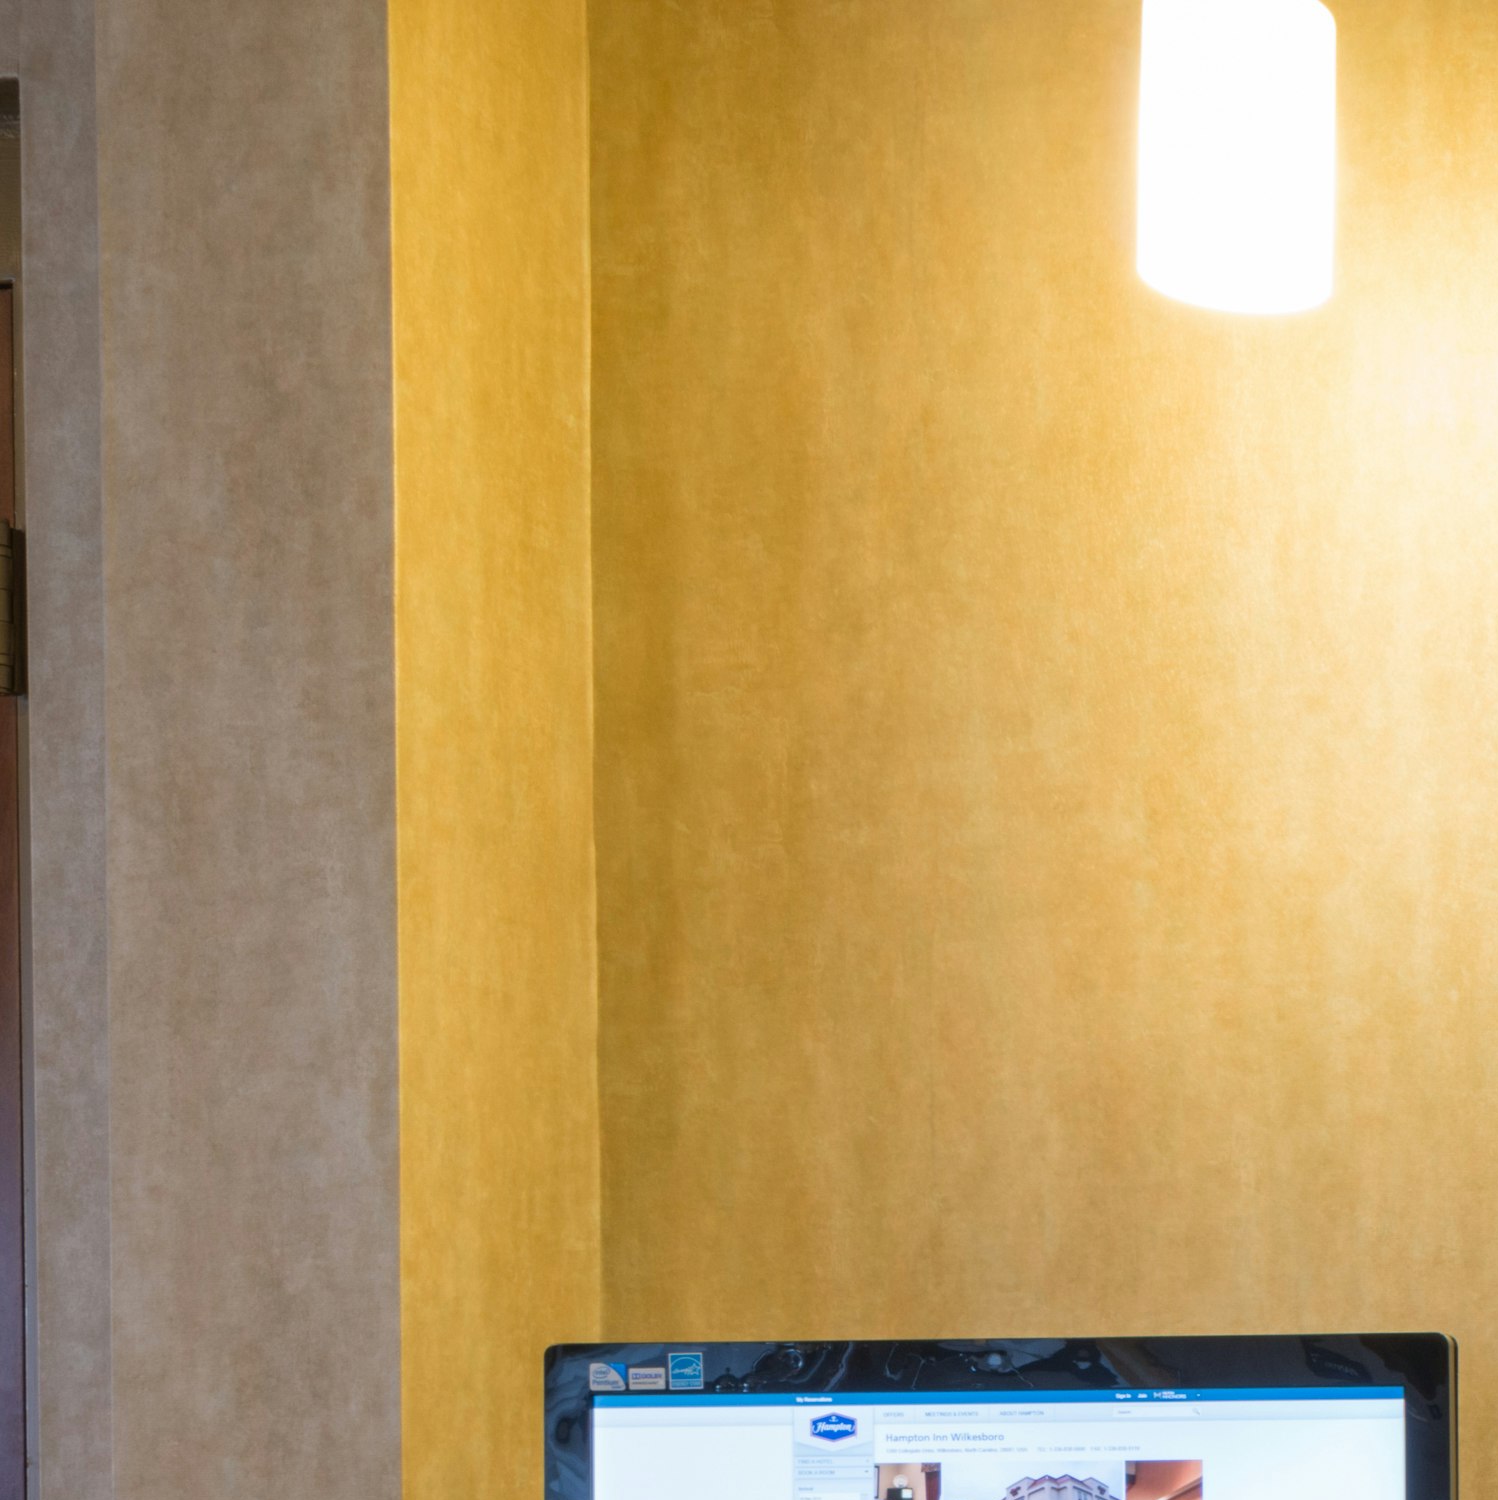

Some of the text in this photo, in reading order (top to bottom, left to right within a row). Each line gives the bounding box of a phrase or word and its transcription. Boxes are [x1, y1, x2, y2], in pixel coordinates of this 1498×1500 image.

[812, 1421, 856, 1435] Hampton
[886, 1433, 1004, 1443] Hampton Inn Wilkesboro
